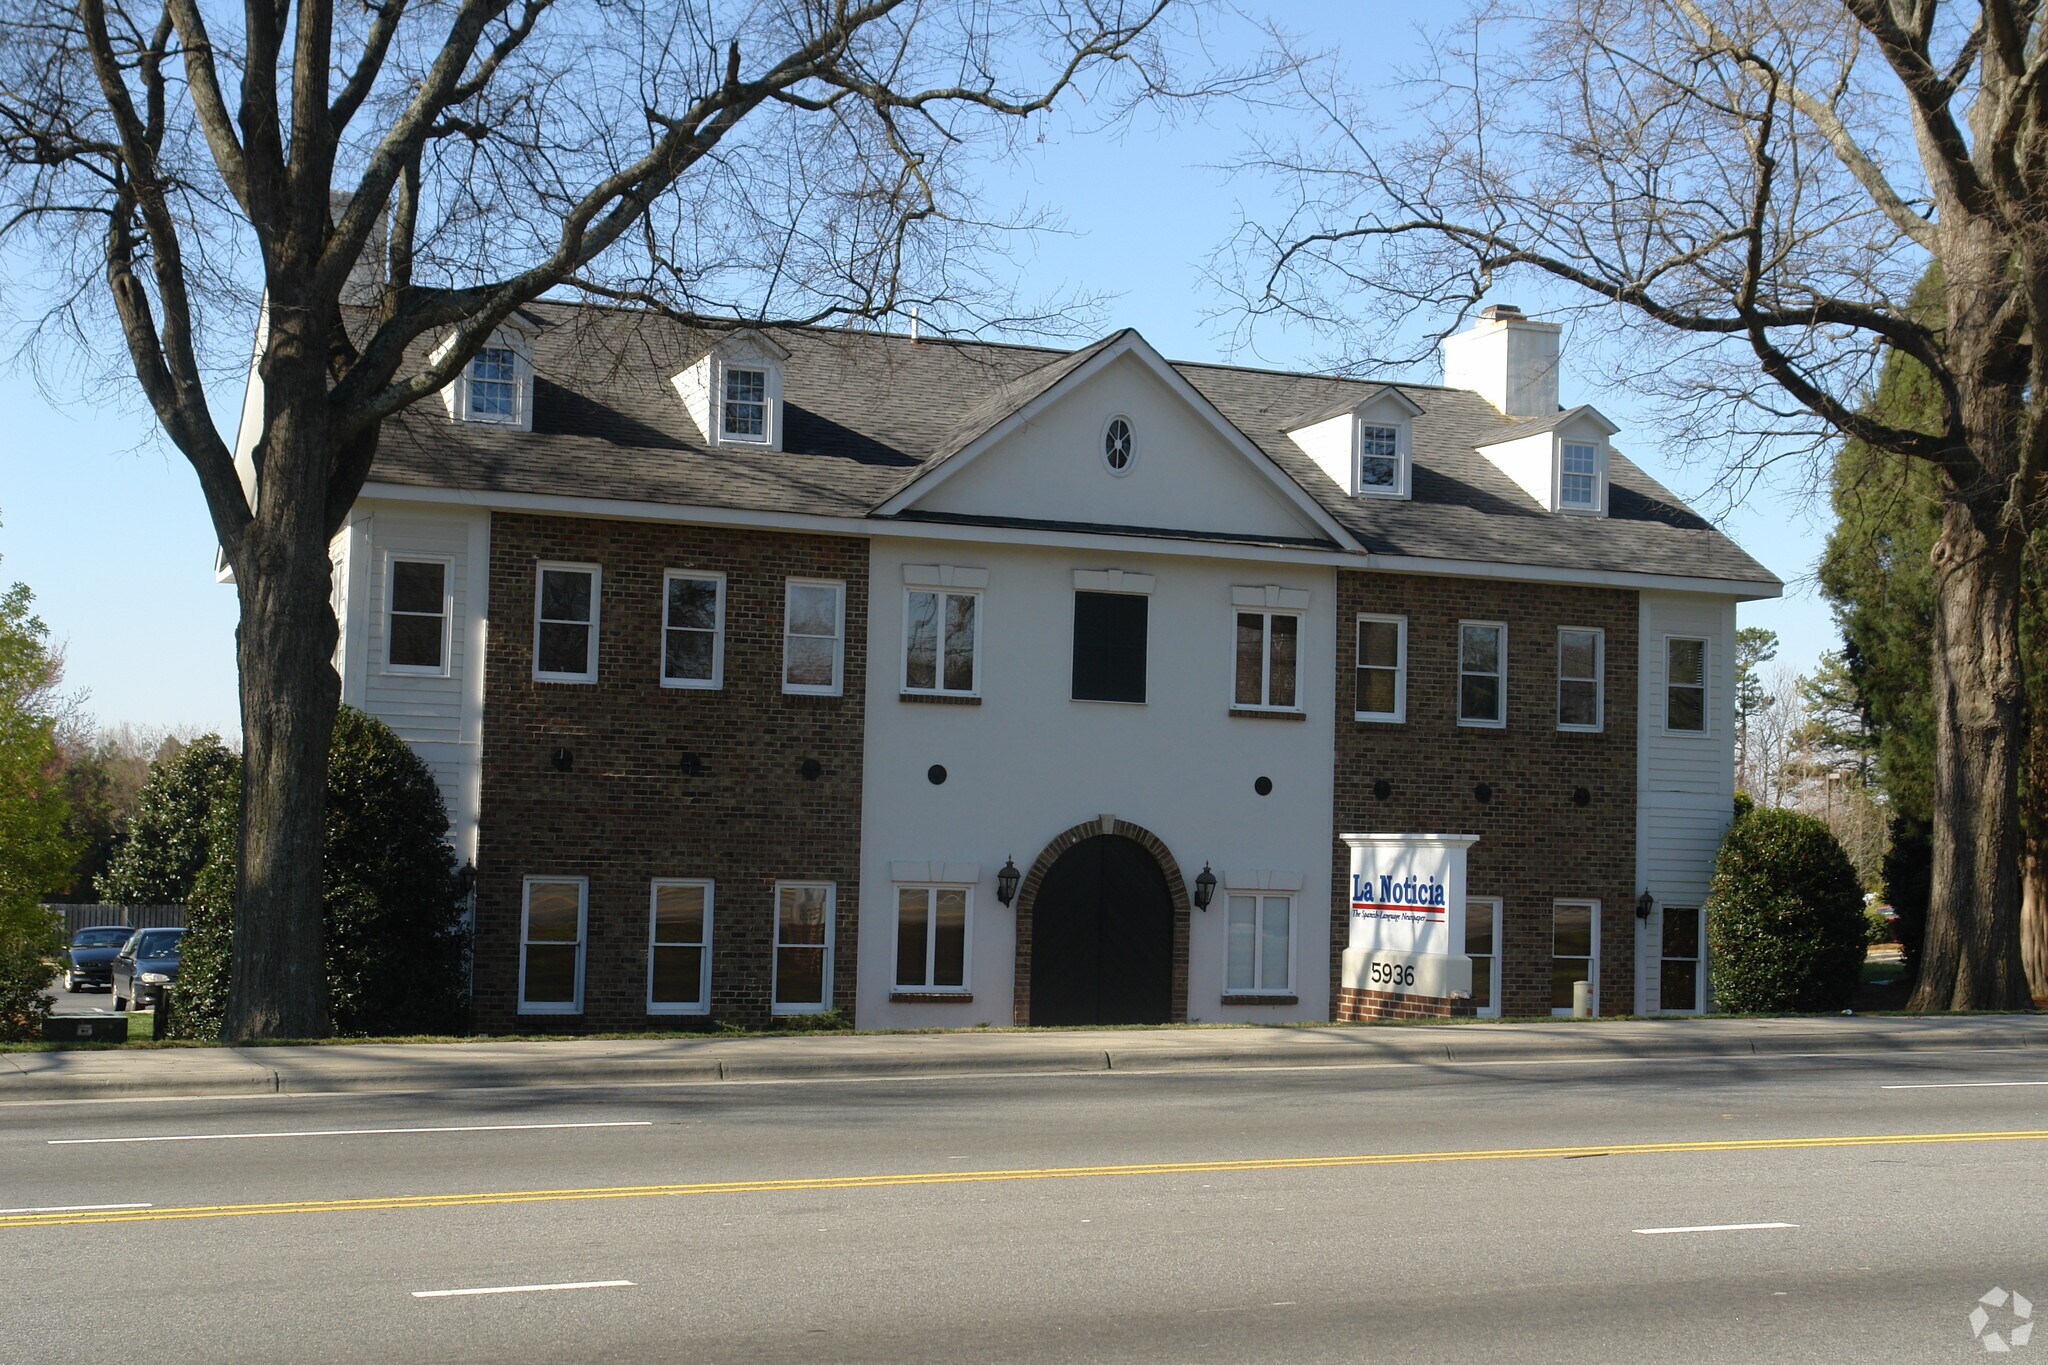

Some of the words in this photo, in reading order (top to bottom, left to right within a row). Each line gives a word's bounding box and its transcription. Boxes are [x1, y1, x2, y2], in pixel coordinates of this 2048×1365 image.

[1353, 874, 1374, 902] La
[1380, 875, 1445, 905] Noticia
[1352, 909, 1361, 918] The
[1401, 912, 1426, 924] Newspaper
[1371, 962, 1415, 987] 5936
